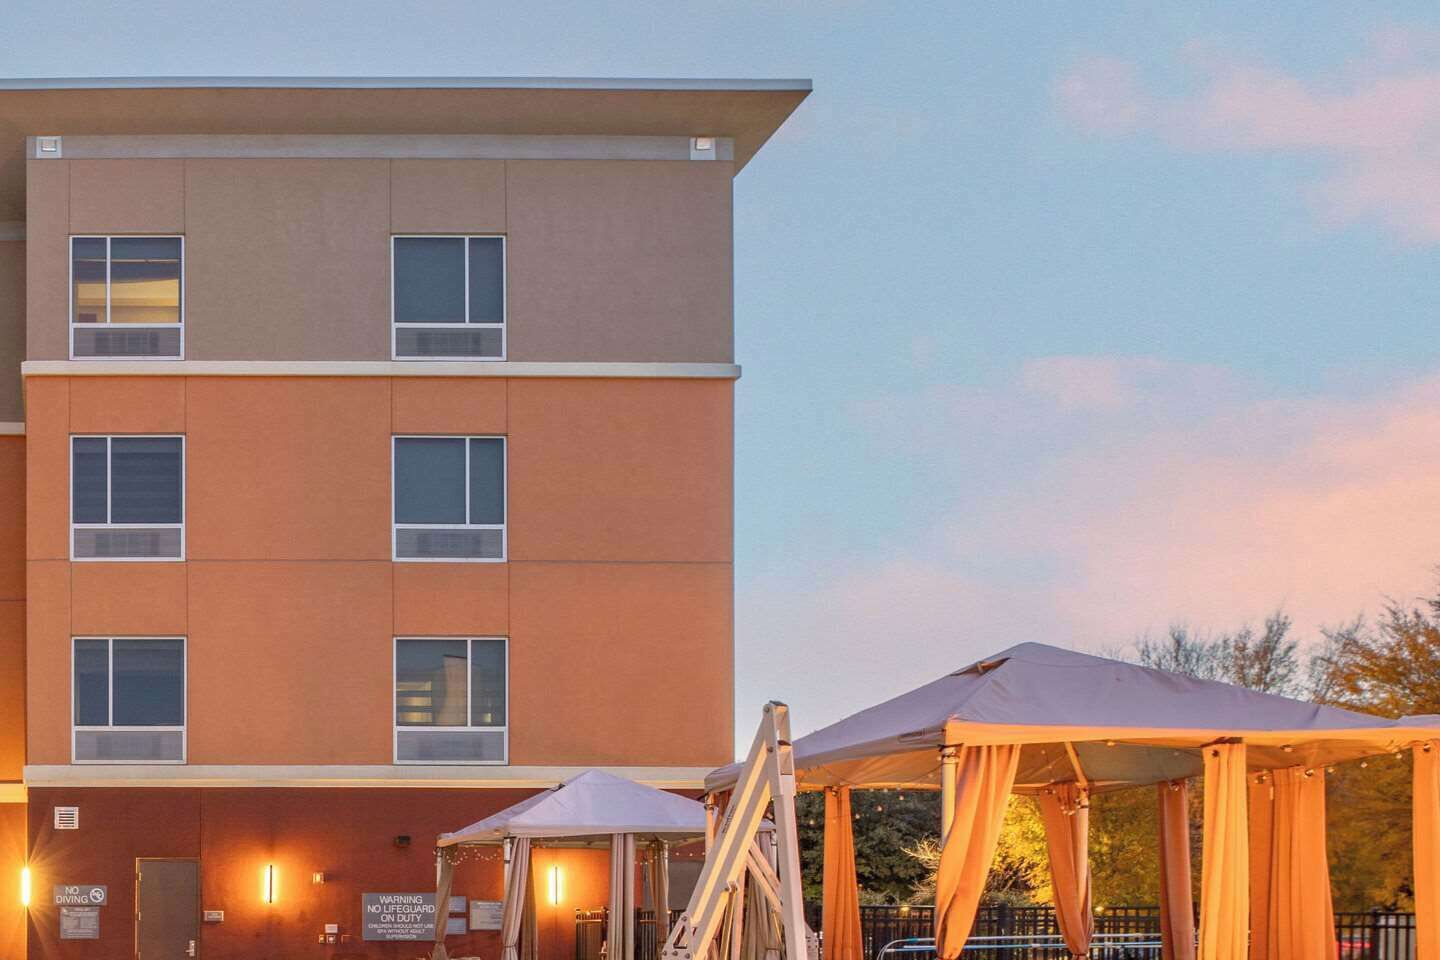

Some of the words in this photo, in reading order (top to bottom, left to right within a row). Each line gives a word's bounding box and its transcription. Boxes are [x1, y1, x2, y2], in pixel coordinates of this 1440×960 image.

[64, 886, 80, 895] NO
[55, 895, 89, 904] DIVING
[379, 895, 423, 904] WARNING
[367, 904, 382, 913] NO
[383, 904, 436, 914] LIFEGUARD
[380, 913, 395, 923] ON
[397, 913, 422, 923] DUTY
